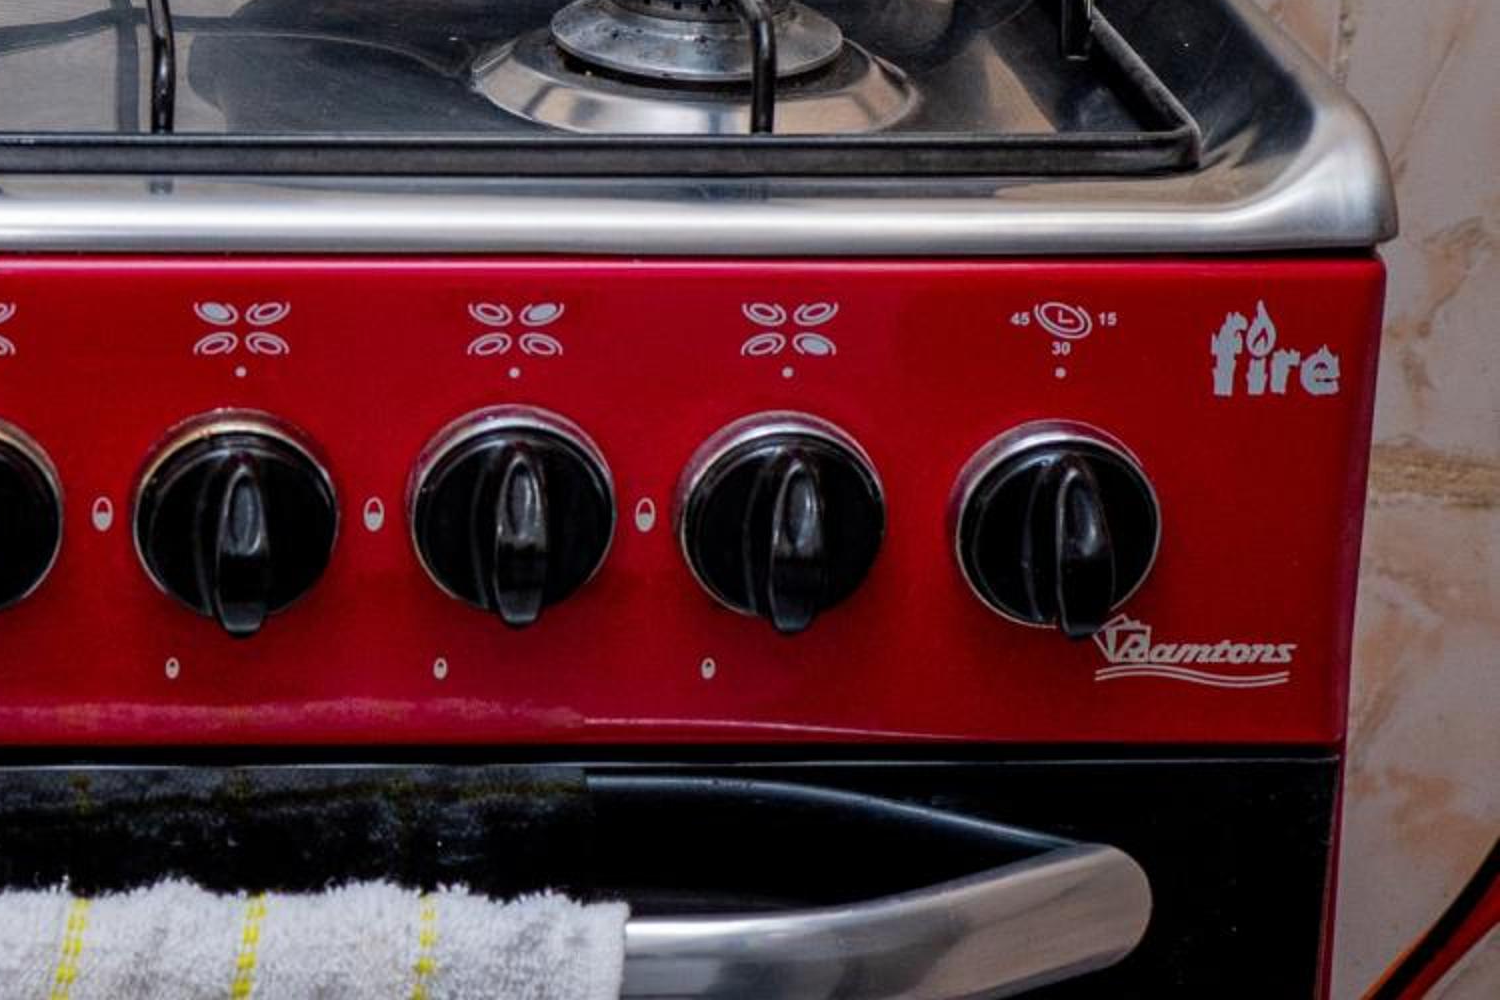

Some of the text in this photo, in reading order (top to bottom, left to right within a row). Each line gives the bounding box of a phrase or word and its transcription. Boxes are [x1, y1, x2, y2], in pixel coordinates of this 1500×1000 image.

[1010, 311, 1031, 326] 45
[1098, 311, 1118, 326] 15
[1051, 341, 1072, 356] 30
[1211, 299, 1341, 396] fire
[1096, 616, 1297, 664] Ramtons
